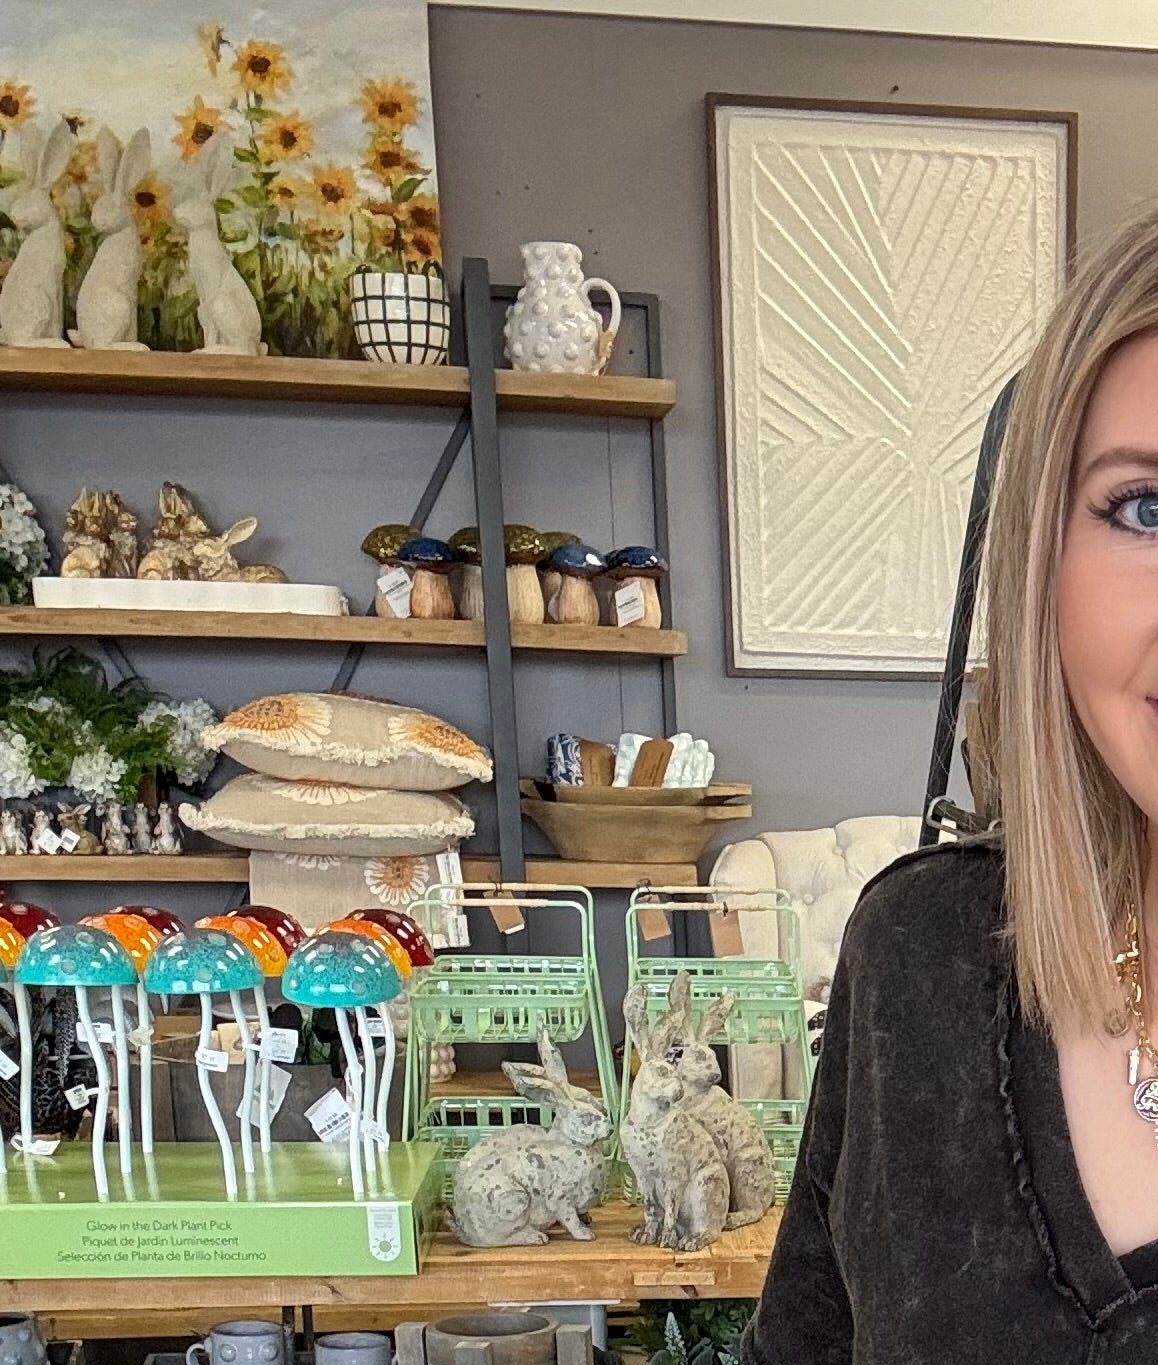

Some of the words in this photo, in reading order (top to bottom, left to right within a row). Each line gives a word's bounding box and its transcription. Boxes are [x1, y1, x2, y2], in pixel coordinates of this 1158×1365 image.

[86, 1220, 118, 1231] Glow
[119, 1221, 130, 1231] in
[132, 1220, 150, 1231] the
[152, 1219, 179, 1231] Dark
[181, 1220, 208, 1231] Plant
[209, 1220, 232, 1231] Pick
[82, 1236, 118, 1248] Piquet
[120, 1236, 135, 1246] de
[170, 1236, 239, 1247] Luminescent
[113, 1252, 129, 1262] de
[131, 1251, 165, 1262] Planta
[166, 1251, 181, 1262] de
[183, 1250, 212, 1261] Brillo
